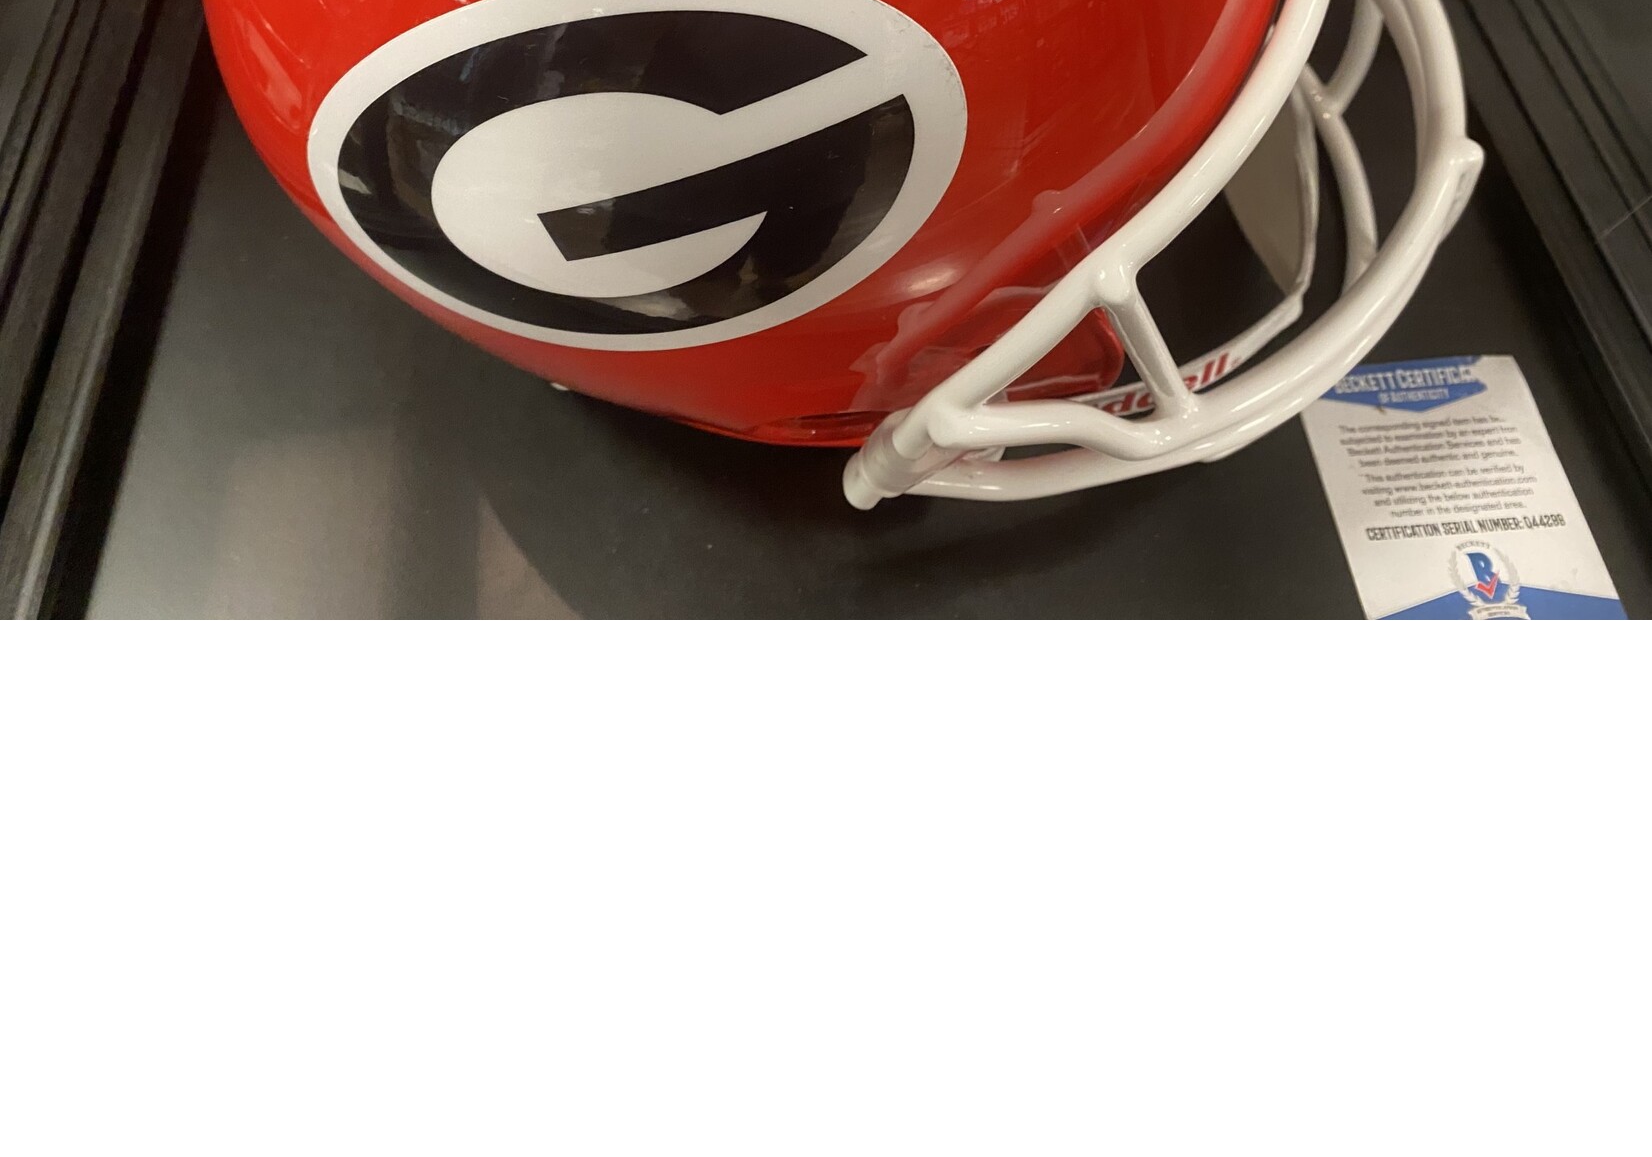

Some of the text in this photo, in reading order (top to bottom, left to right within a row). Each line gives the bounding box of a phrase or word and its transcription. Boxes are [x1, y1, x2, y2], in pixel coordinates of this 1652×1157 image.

[337, 10, 915, 335] G
[1390, 387, 1449, 403] AUTHENTICITY
[1339, 424, 1356, 433] The
[1358, 421, 1421, 432] corresponding
[1422, 418, 1450, 429] signed
[1453, 417, 1469, 425] item
[1472, 415, 1487, 424] has
[1340, 434, 1382, 446] subjected
[1384, 434, 1393, 442] to
[1395, 431, 1443, 441] examination
[1446, 430, 1457, 439] by
[1472, 426, 1498, 436] expert
[1347, 437, 1521, 456] Beckett Authentication Services and has
[1359, 449, 1518, 467] been deemed authentic and genuine.
[1366, 464, 1524, 482] This authentication can be verified by
[1362, 486, 1393, 496] visiting
[1374, 488, 1534, 506] and utilizing the below authentication
[1390, 500, 1527, 518] number in the designated area.
[1365, 523, 1441, 541] CERTIFICATION
[1442, 520, 1478, 536] SERIAL
[1478, 517, 1522, 533] NUMBER:
